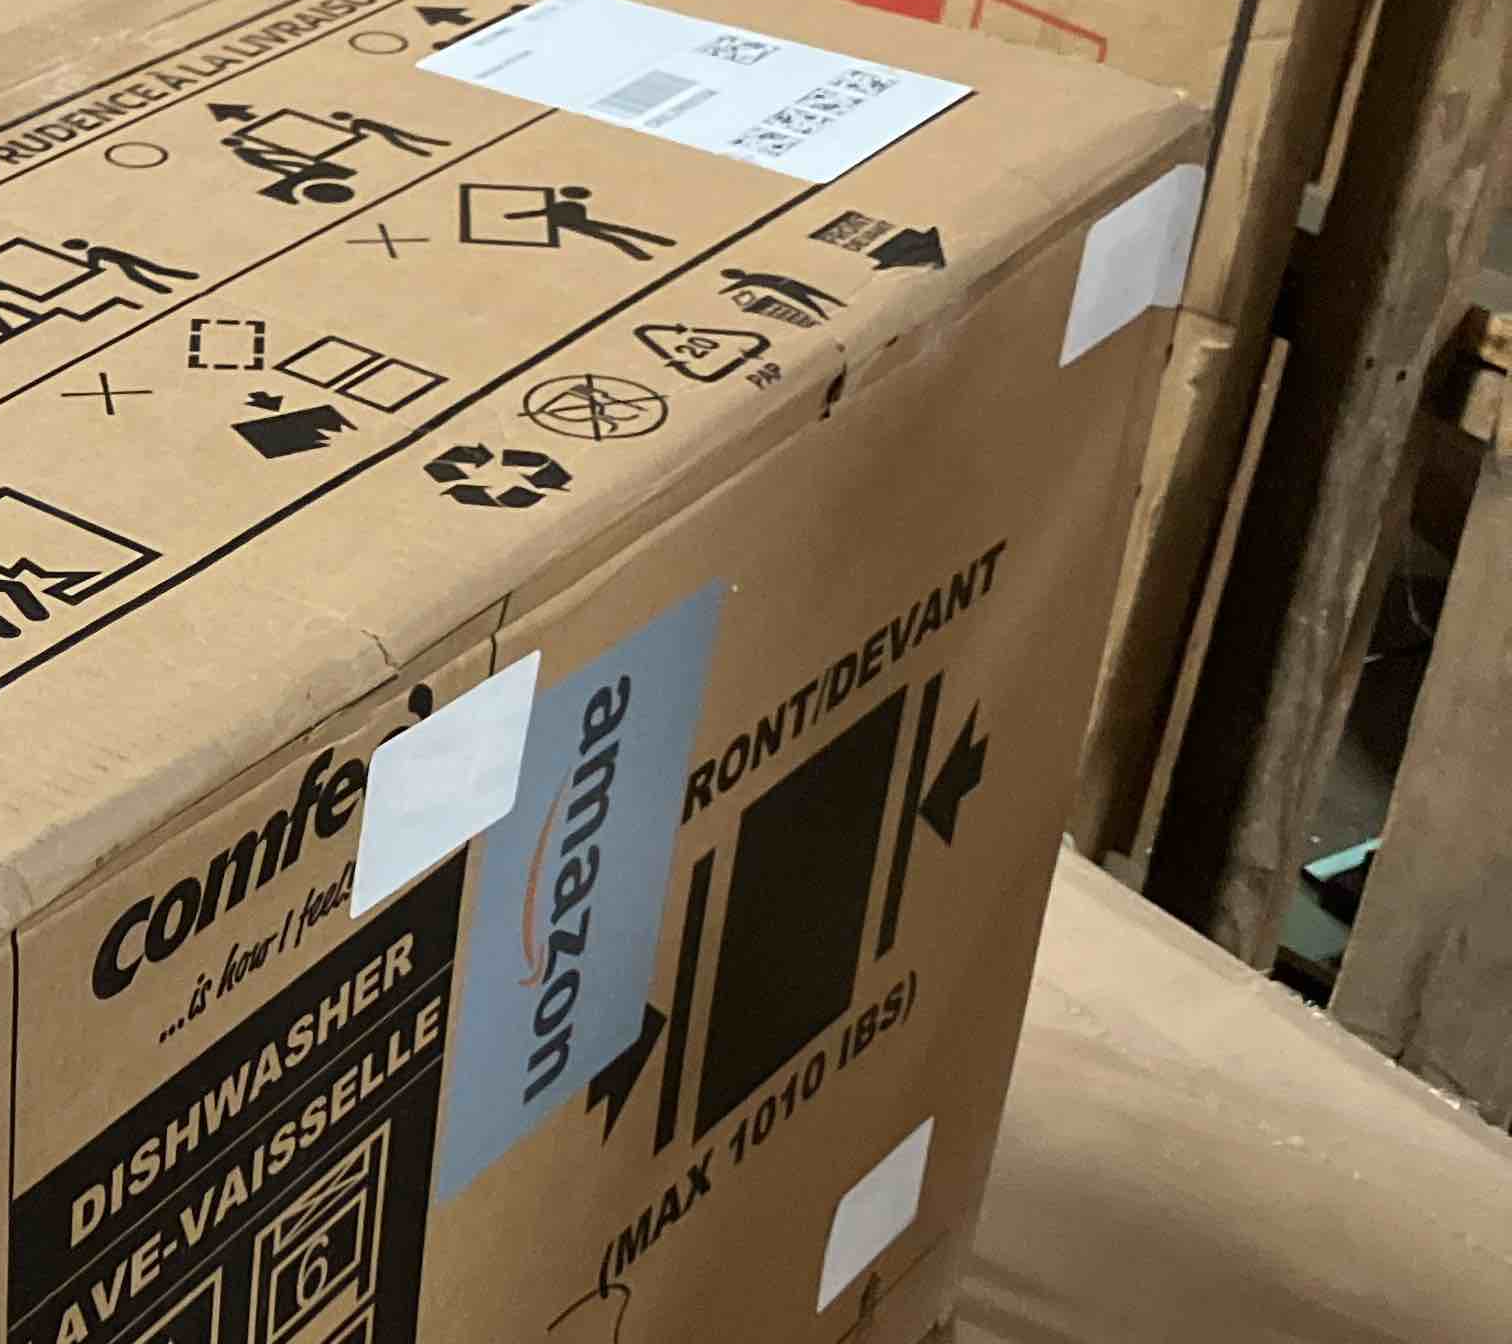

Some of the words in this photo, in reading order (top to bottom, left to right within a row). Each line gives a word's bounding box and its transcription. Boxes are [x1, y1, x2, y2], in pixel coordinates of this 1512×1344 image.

[186, 46, 232, 81] LA
[675, 337, 719, 358] 20
[745, 362, 781, 389] PAP
[682, 539, 1008, 825] RONT/DEVANT
[523, 673, 632, 1105] amazon
[216, 943, 278, 998] how
[277, 909, 296, 953] I
[70, 931, 415, 1249] DISHWASHER
[599, 1163, 712, 1300] (MAX
